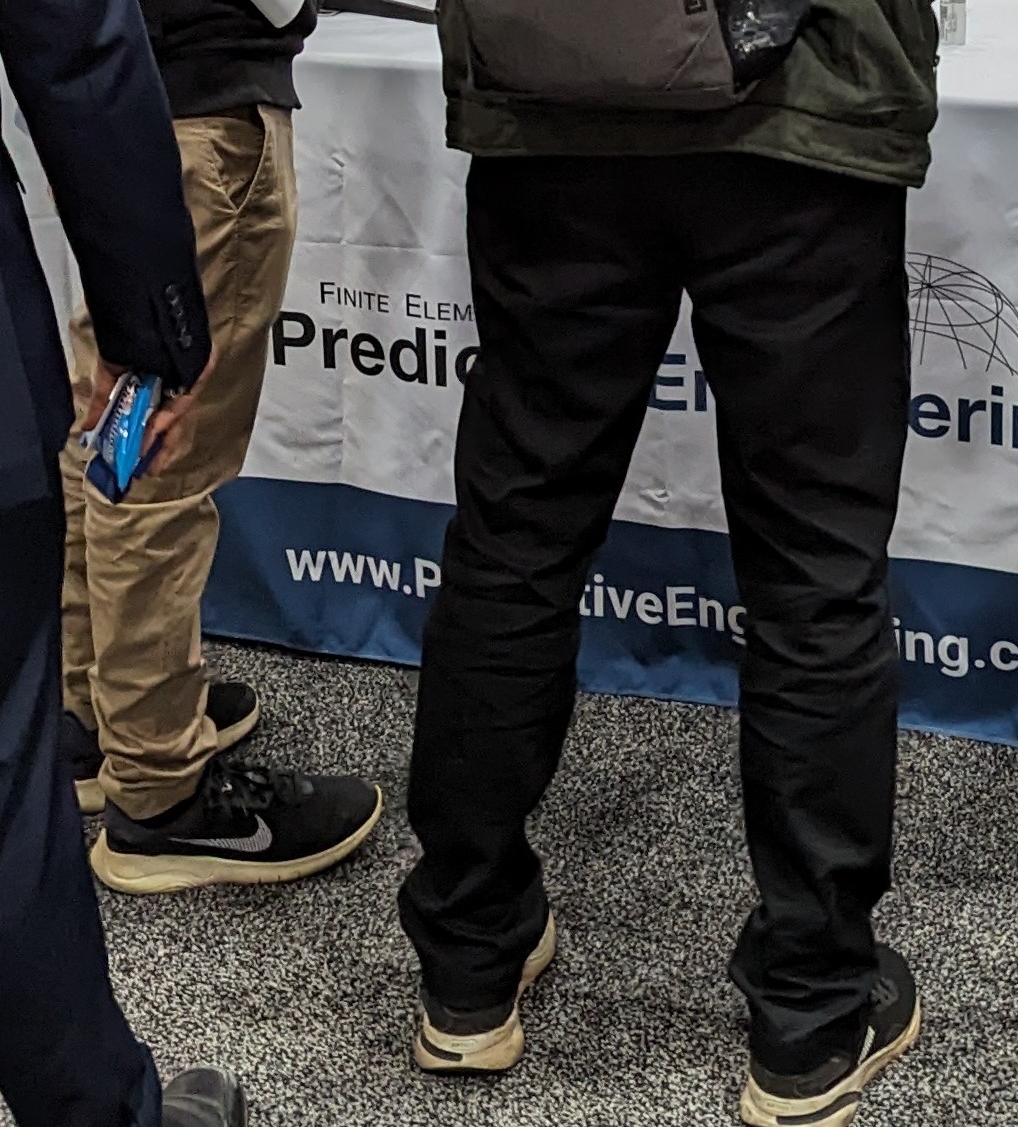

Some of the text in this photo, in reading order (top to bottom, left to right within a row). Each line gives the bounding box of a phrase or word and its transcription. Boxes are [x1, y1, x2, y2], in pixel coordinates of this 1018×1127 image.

[319, 281, 474, 322] FINITE ELEM
[272, 310, 481, 388] Predic
